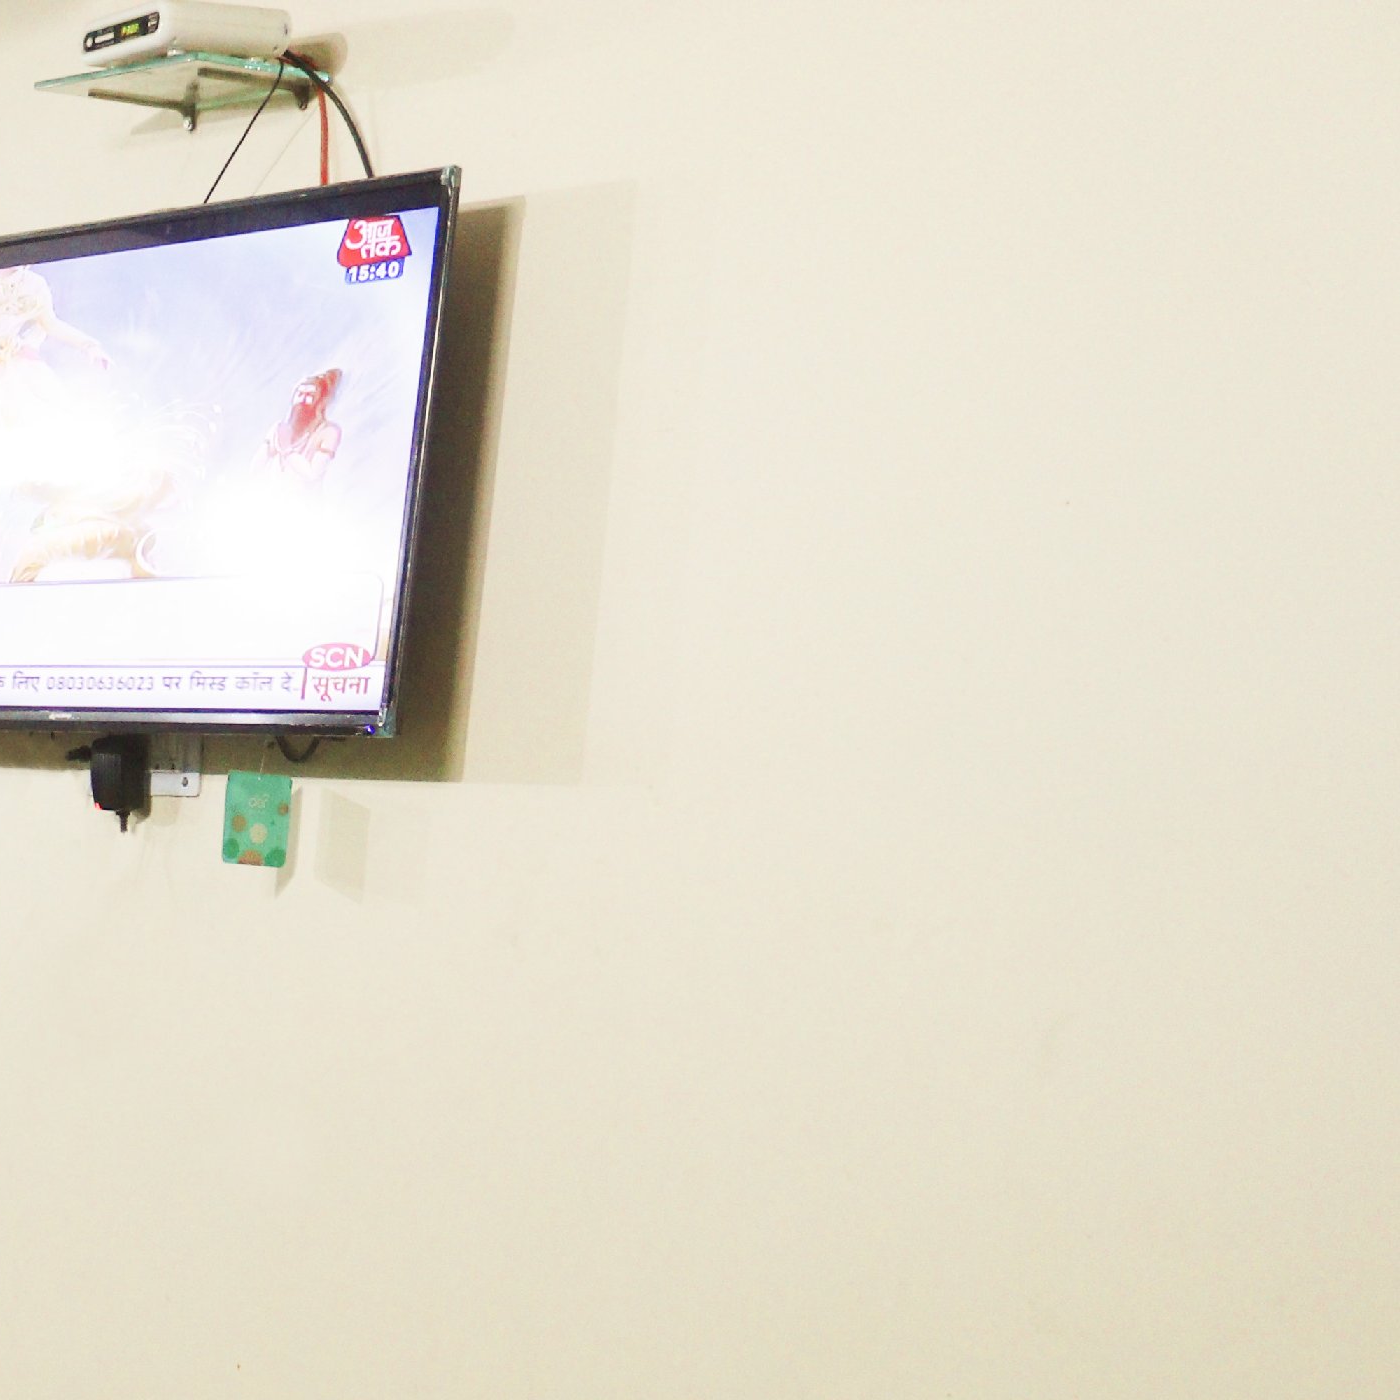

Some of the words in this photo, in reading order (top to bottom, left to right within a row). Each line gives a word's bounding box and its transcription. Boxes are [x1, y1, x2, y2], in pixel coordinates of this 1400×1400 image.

[345, 219, 395, 249] आज
[360, 235, 402, 259] तक
[348, 261, 400, 282] 15:40
[308, 647, 364, 668] SCN
[12, 671, 40, 692] लिए
[162, 676, 182, 691] पर
[189, 671, 228, 692] मिस्ड
[235, 671, 274, 691] कॉल
[312, 675, 371, 702] सूचना
